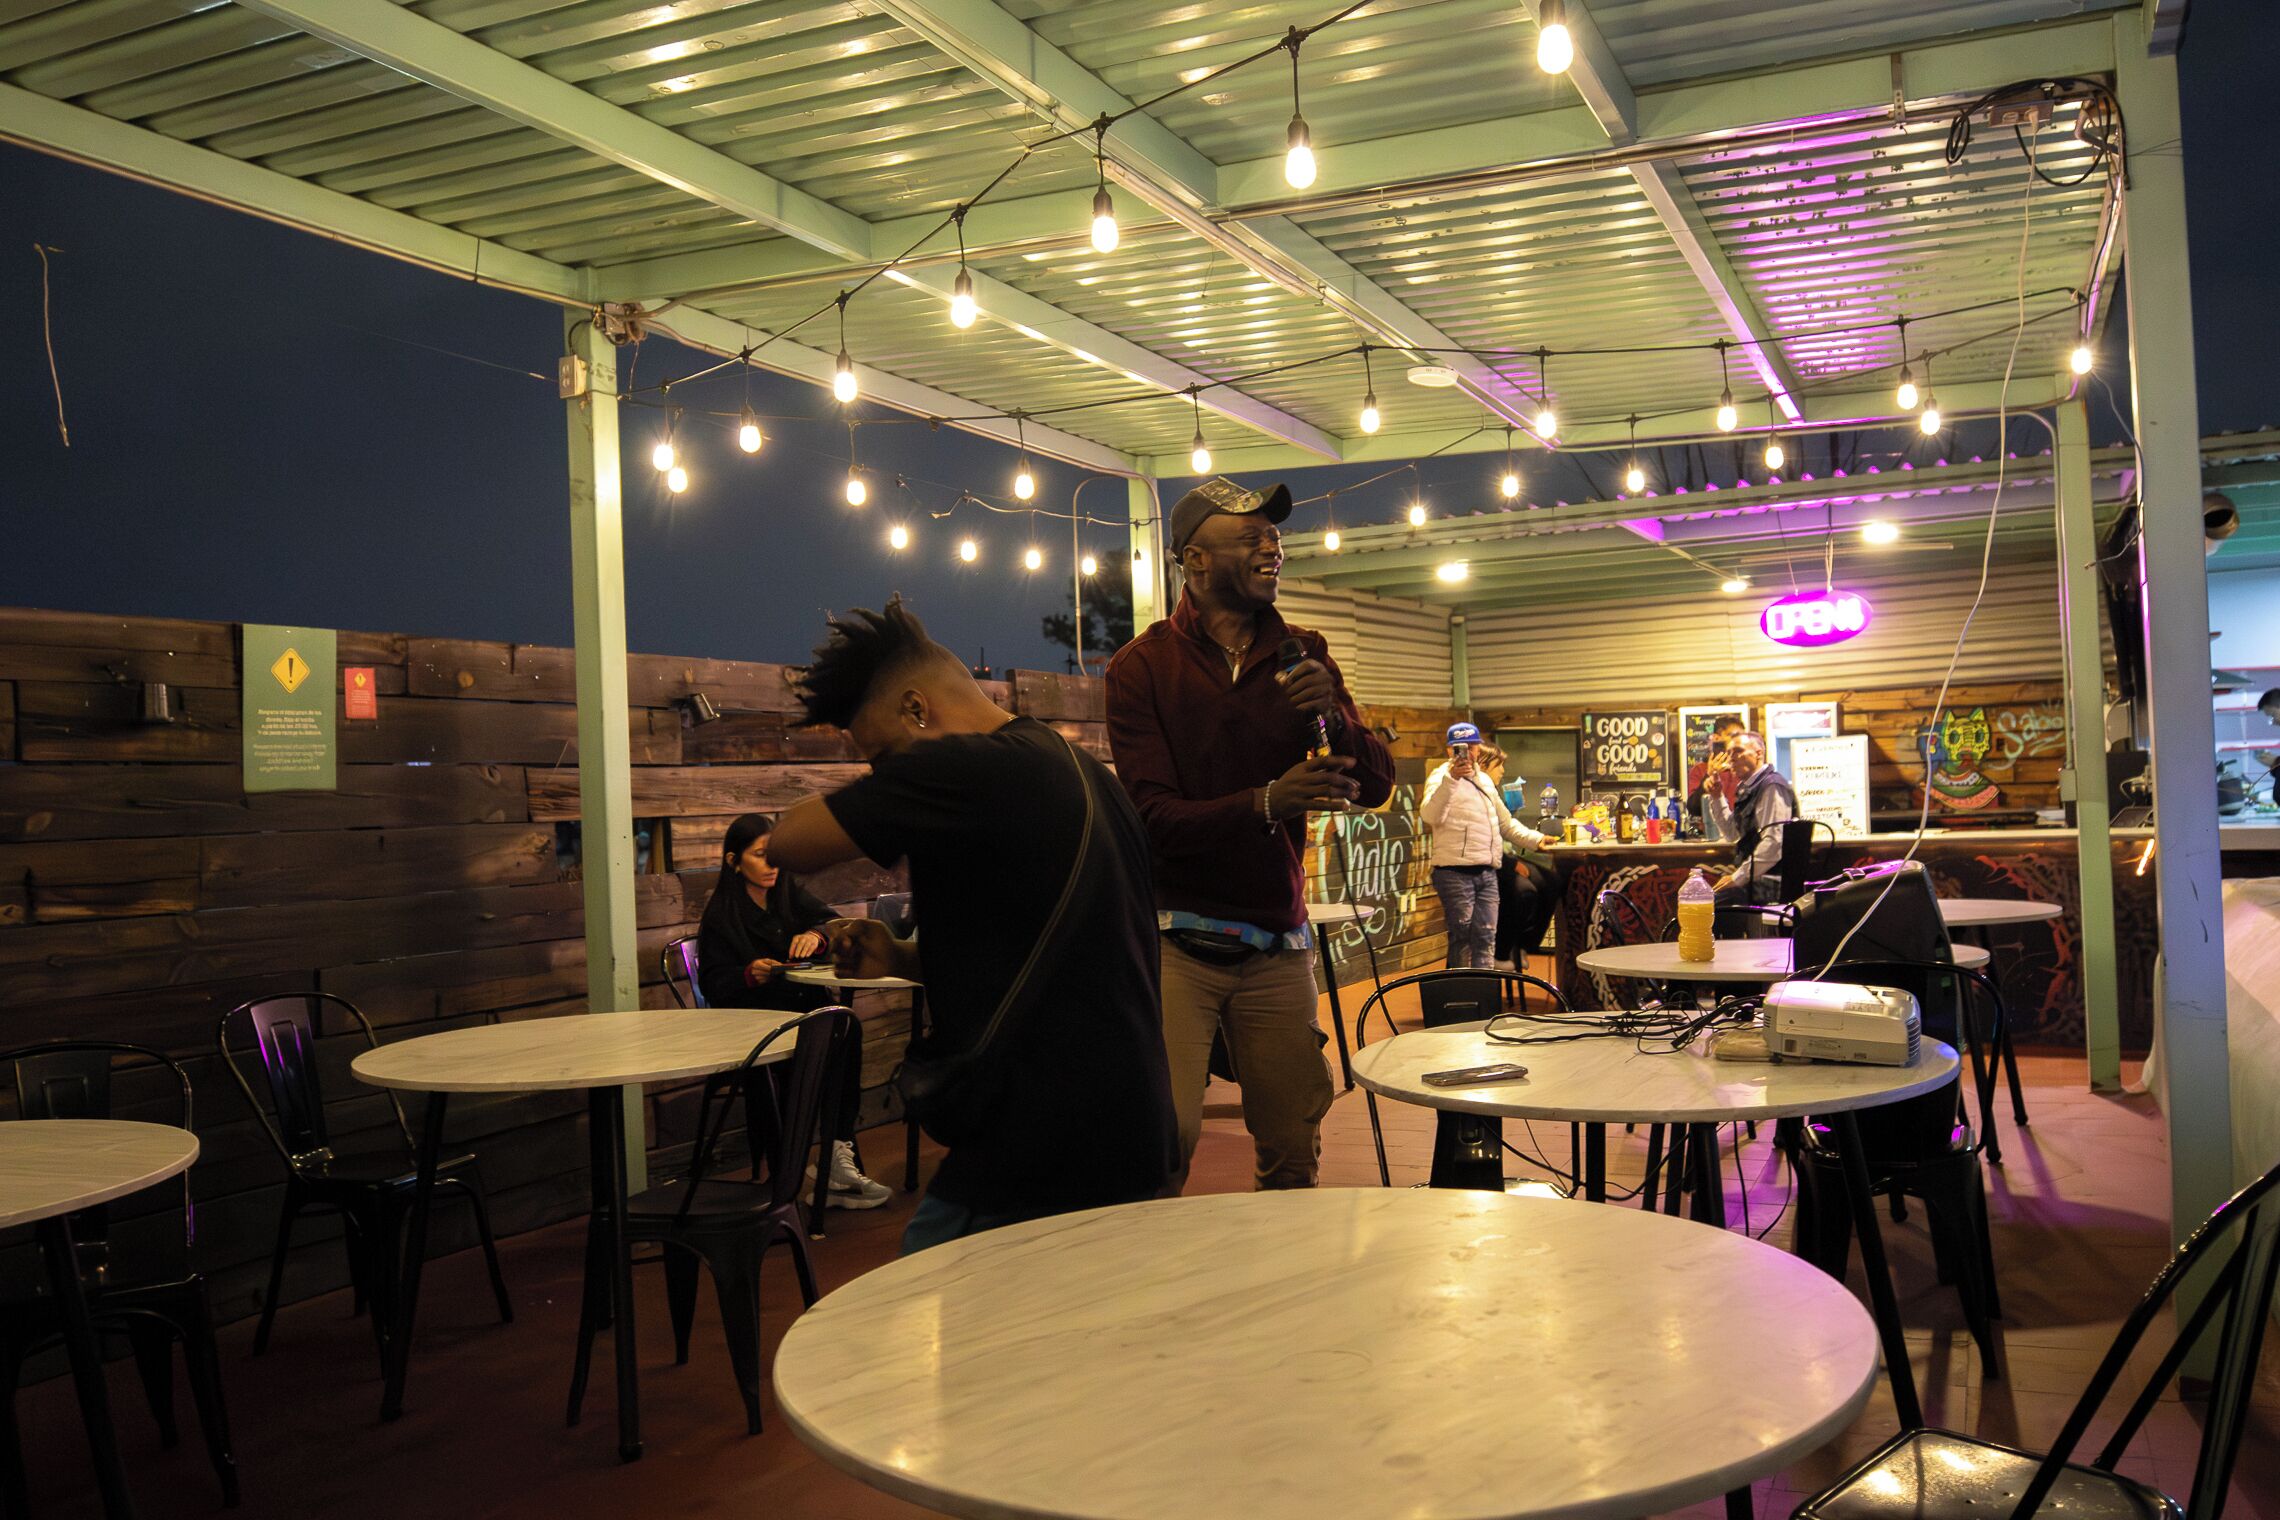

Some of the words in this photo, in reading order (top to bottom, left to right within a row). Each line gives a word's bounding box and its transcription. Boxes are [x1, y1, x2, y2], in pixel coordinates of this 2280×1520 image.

[1766, 597, 1865, 639] OPEN
[1597, 716, 1649, 737] GOOD
[1597, 743, 1649, 764] GOOD
[1609, 762, 1637, 776] friends
